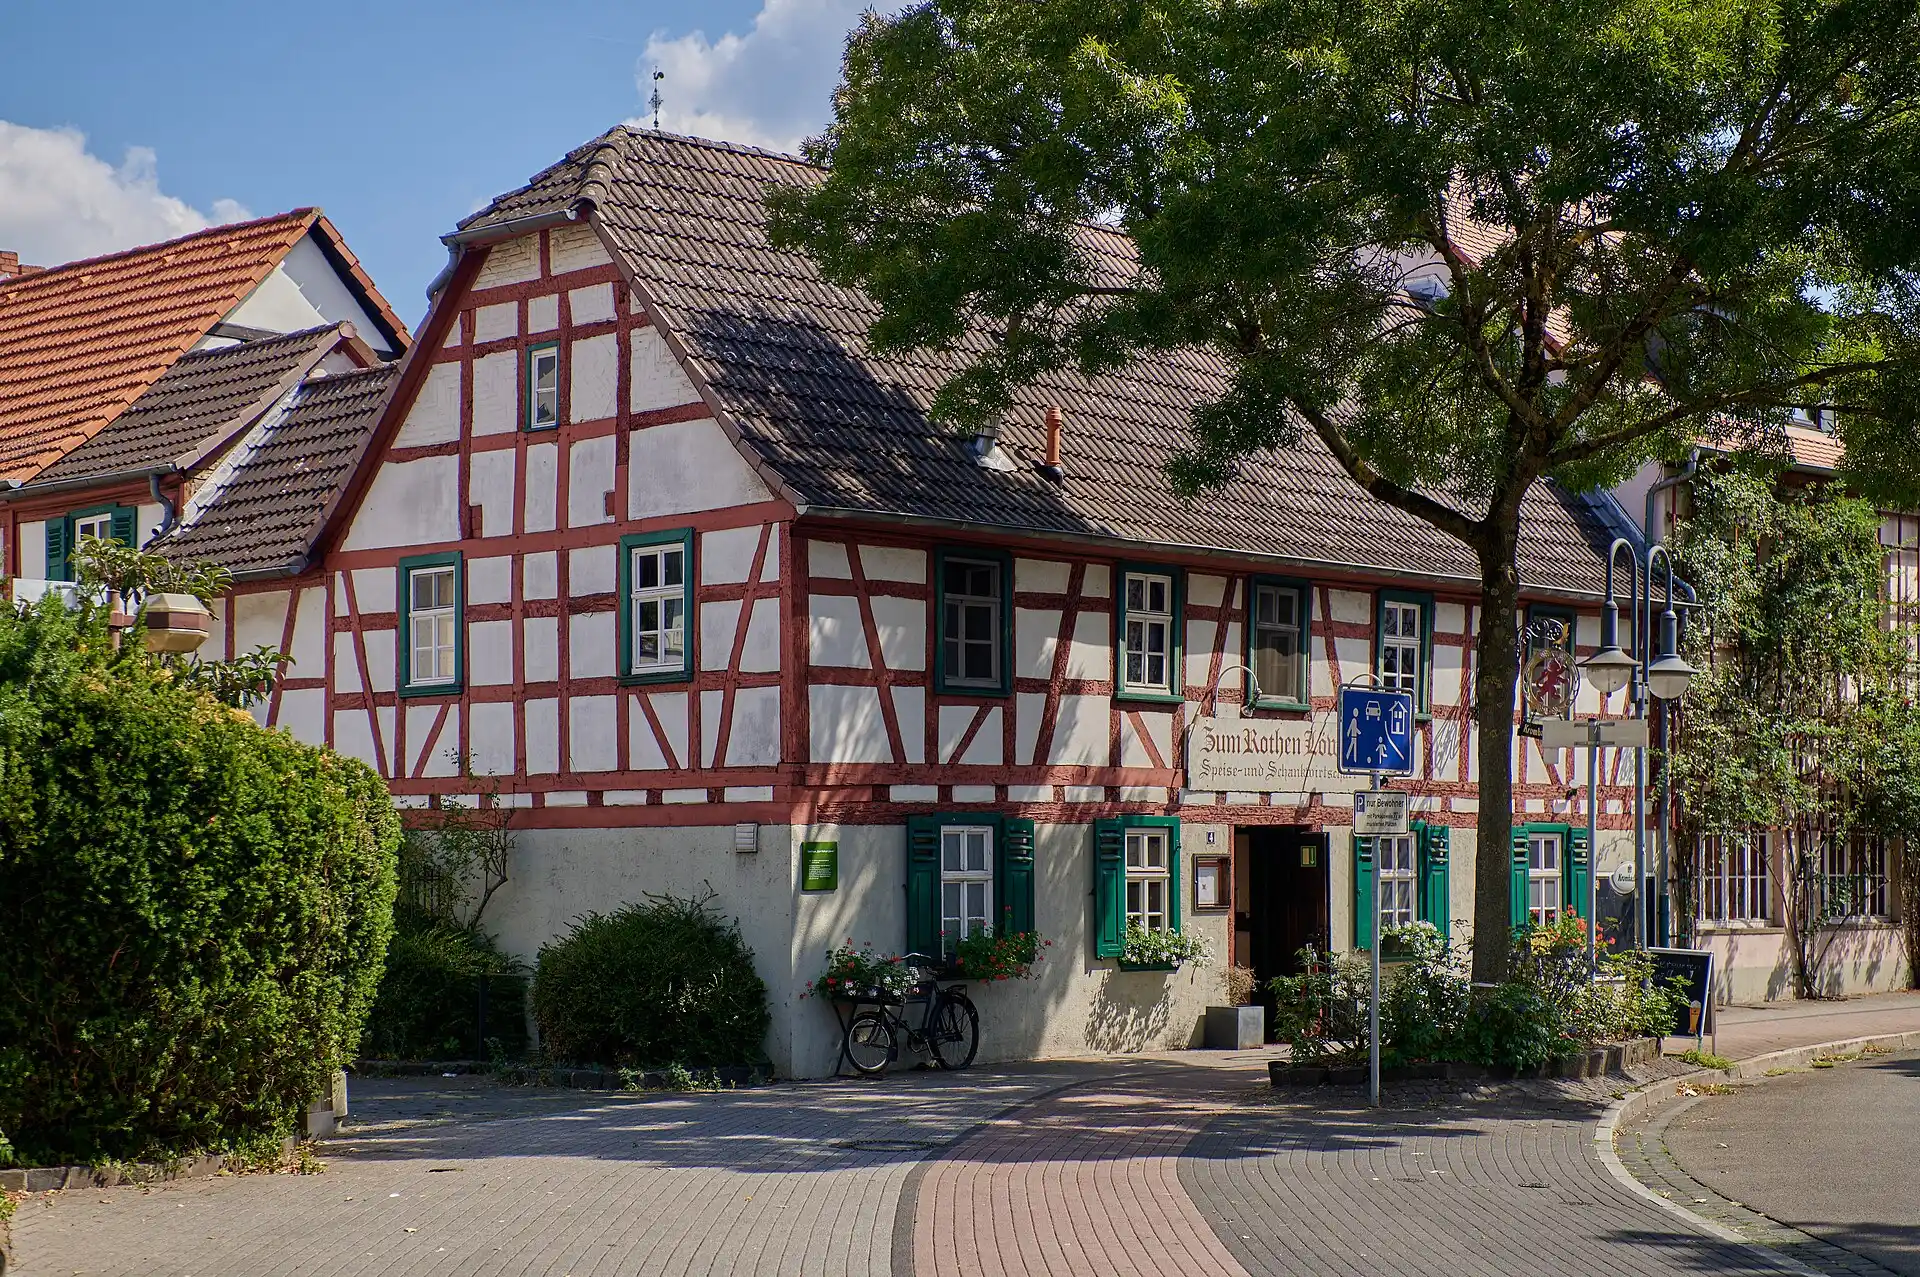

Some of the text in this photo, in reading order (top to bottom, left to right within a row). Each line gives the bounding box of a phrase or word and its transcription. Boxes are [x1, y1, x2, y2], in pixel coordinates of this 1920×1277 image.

[1200, 726, 1241, 754] Zum
[1242, 728, 1301, 760] Rothen
[1366, 799, 1376, 808] nur
[1376, 798, 1405, 808] Bewohner
